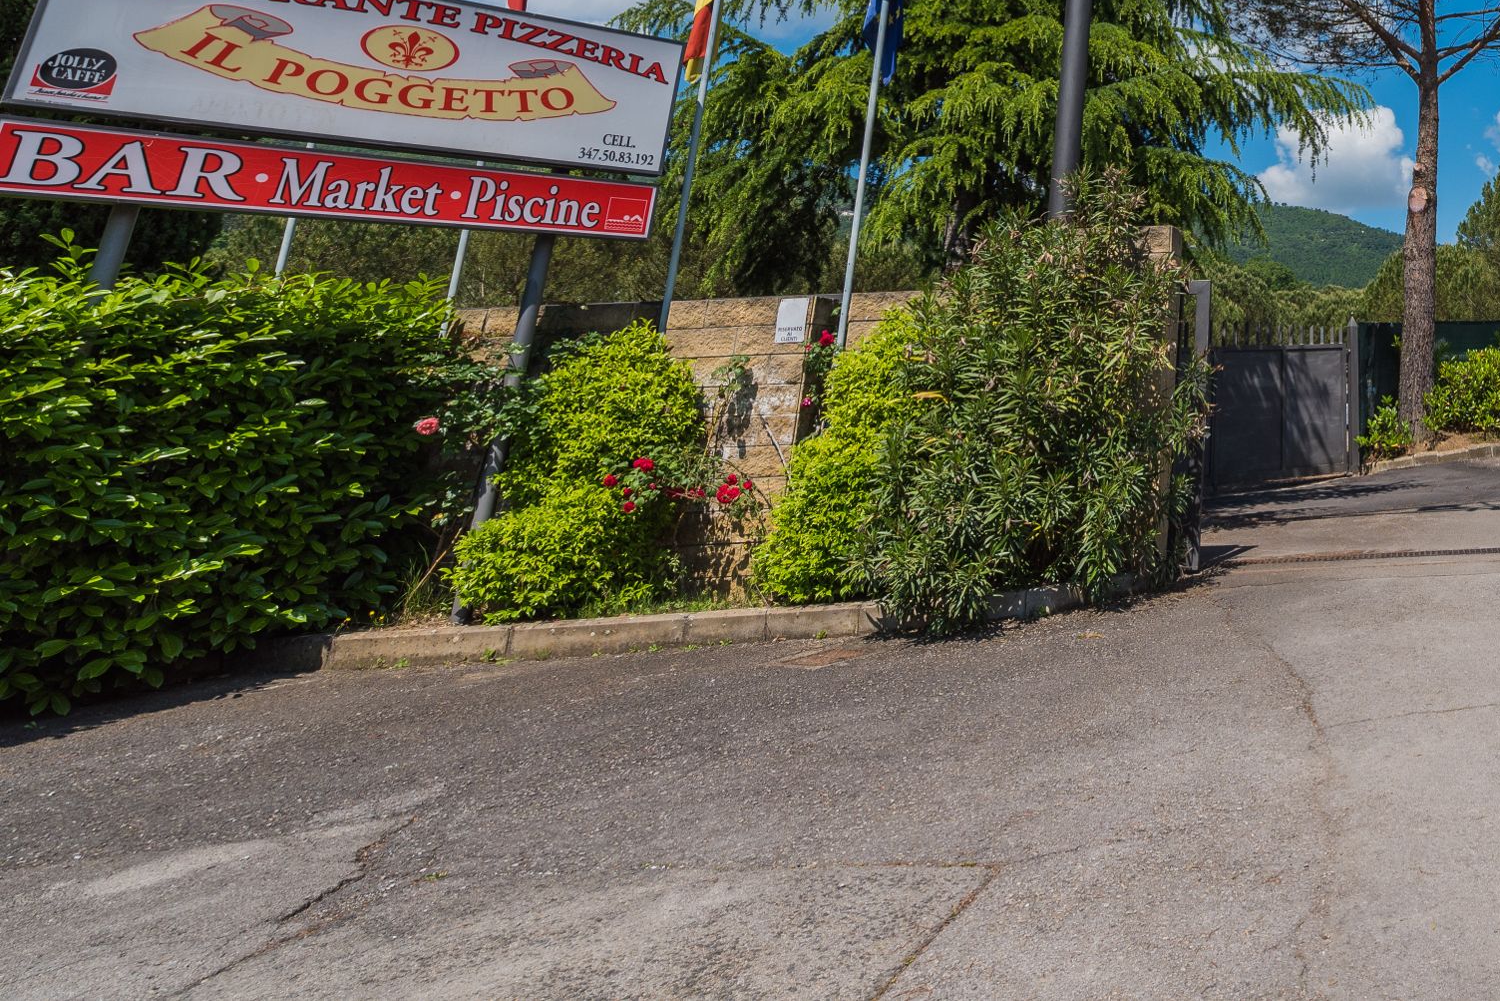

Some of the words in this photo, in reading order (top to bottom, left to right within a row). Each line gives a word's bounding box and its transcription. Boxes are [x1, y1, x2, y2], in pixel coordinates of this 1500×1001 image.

[48, 53, 107, 71] JOLLY
[469, 10, 669, 86] PIZZERIA
[180, 31, 242, 75] IL
[263, 55, 576, 117] POGGETTO
[578, 147, 655, 166] 347.50.83.192
[602, 133, 636, 149] CELL.
[2, 127, 246, 201] BAR
[267, 155, 443, 217] Market
[460, 175, 601, 228] Piscine
